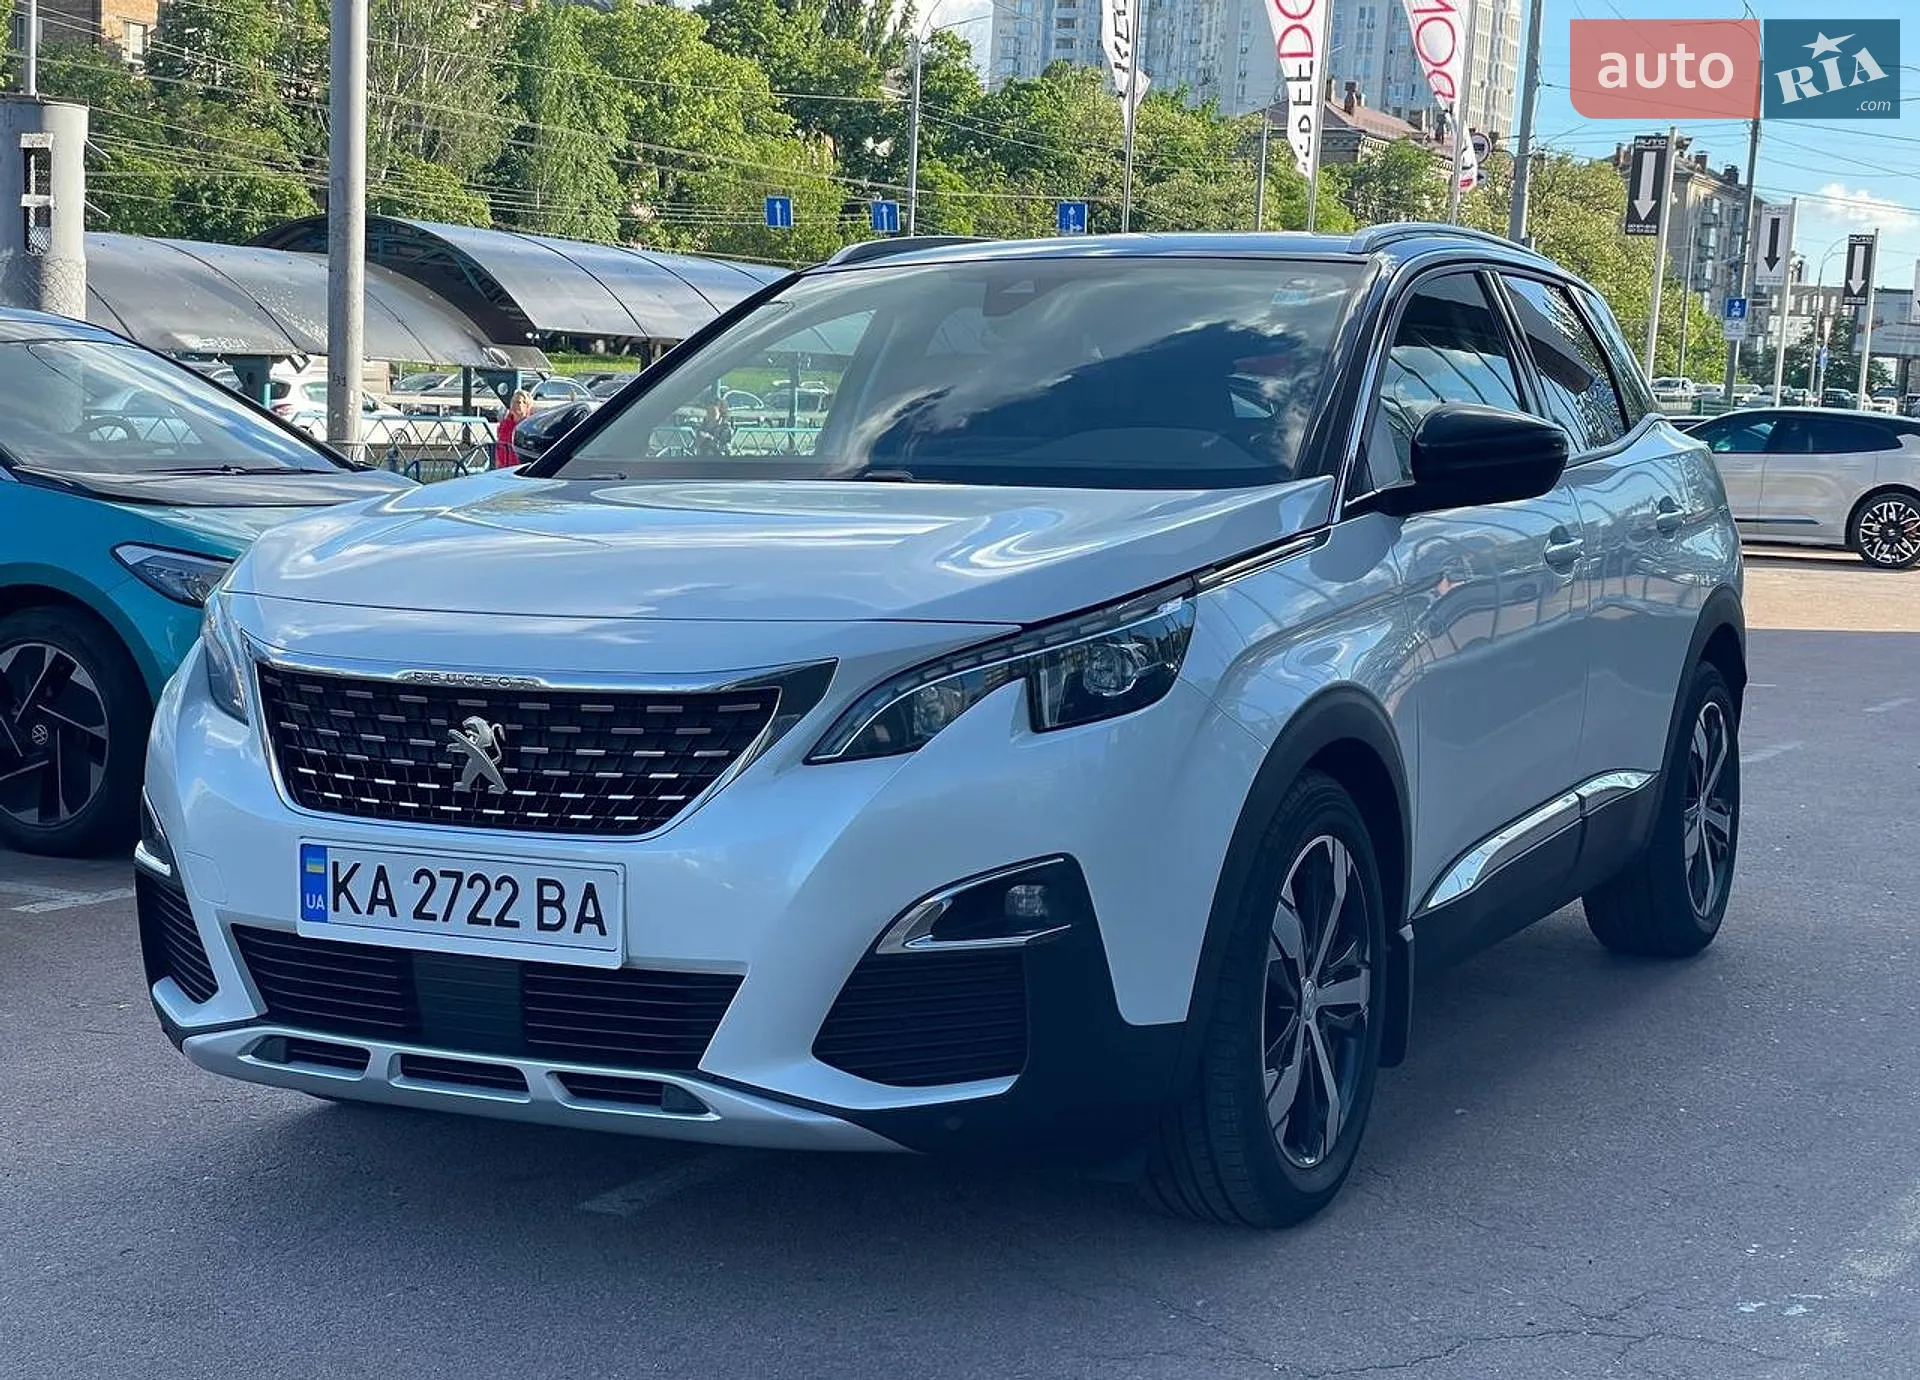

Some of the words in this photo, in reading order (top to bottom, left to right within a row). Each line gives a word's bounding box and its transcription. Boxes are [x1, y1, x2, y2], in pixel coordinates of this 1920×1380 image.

[306, 893, 325, 911] UA
[331, 861, 398, 918] KA
[412, 868, 520, 929] 2722
[536, 878, 608, 937] BA
